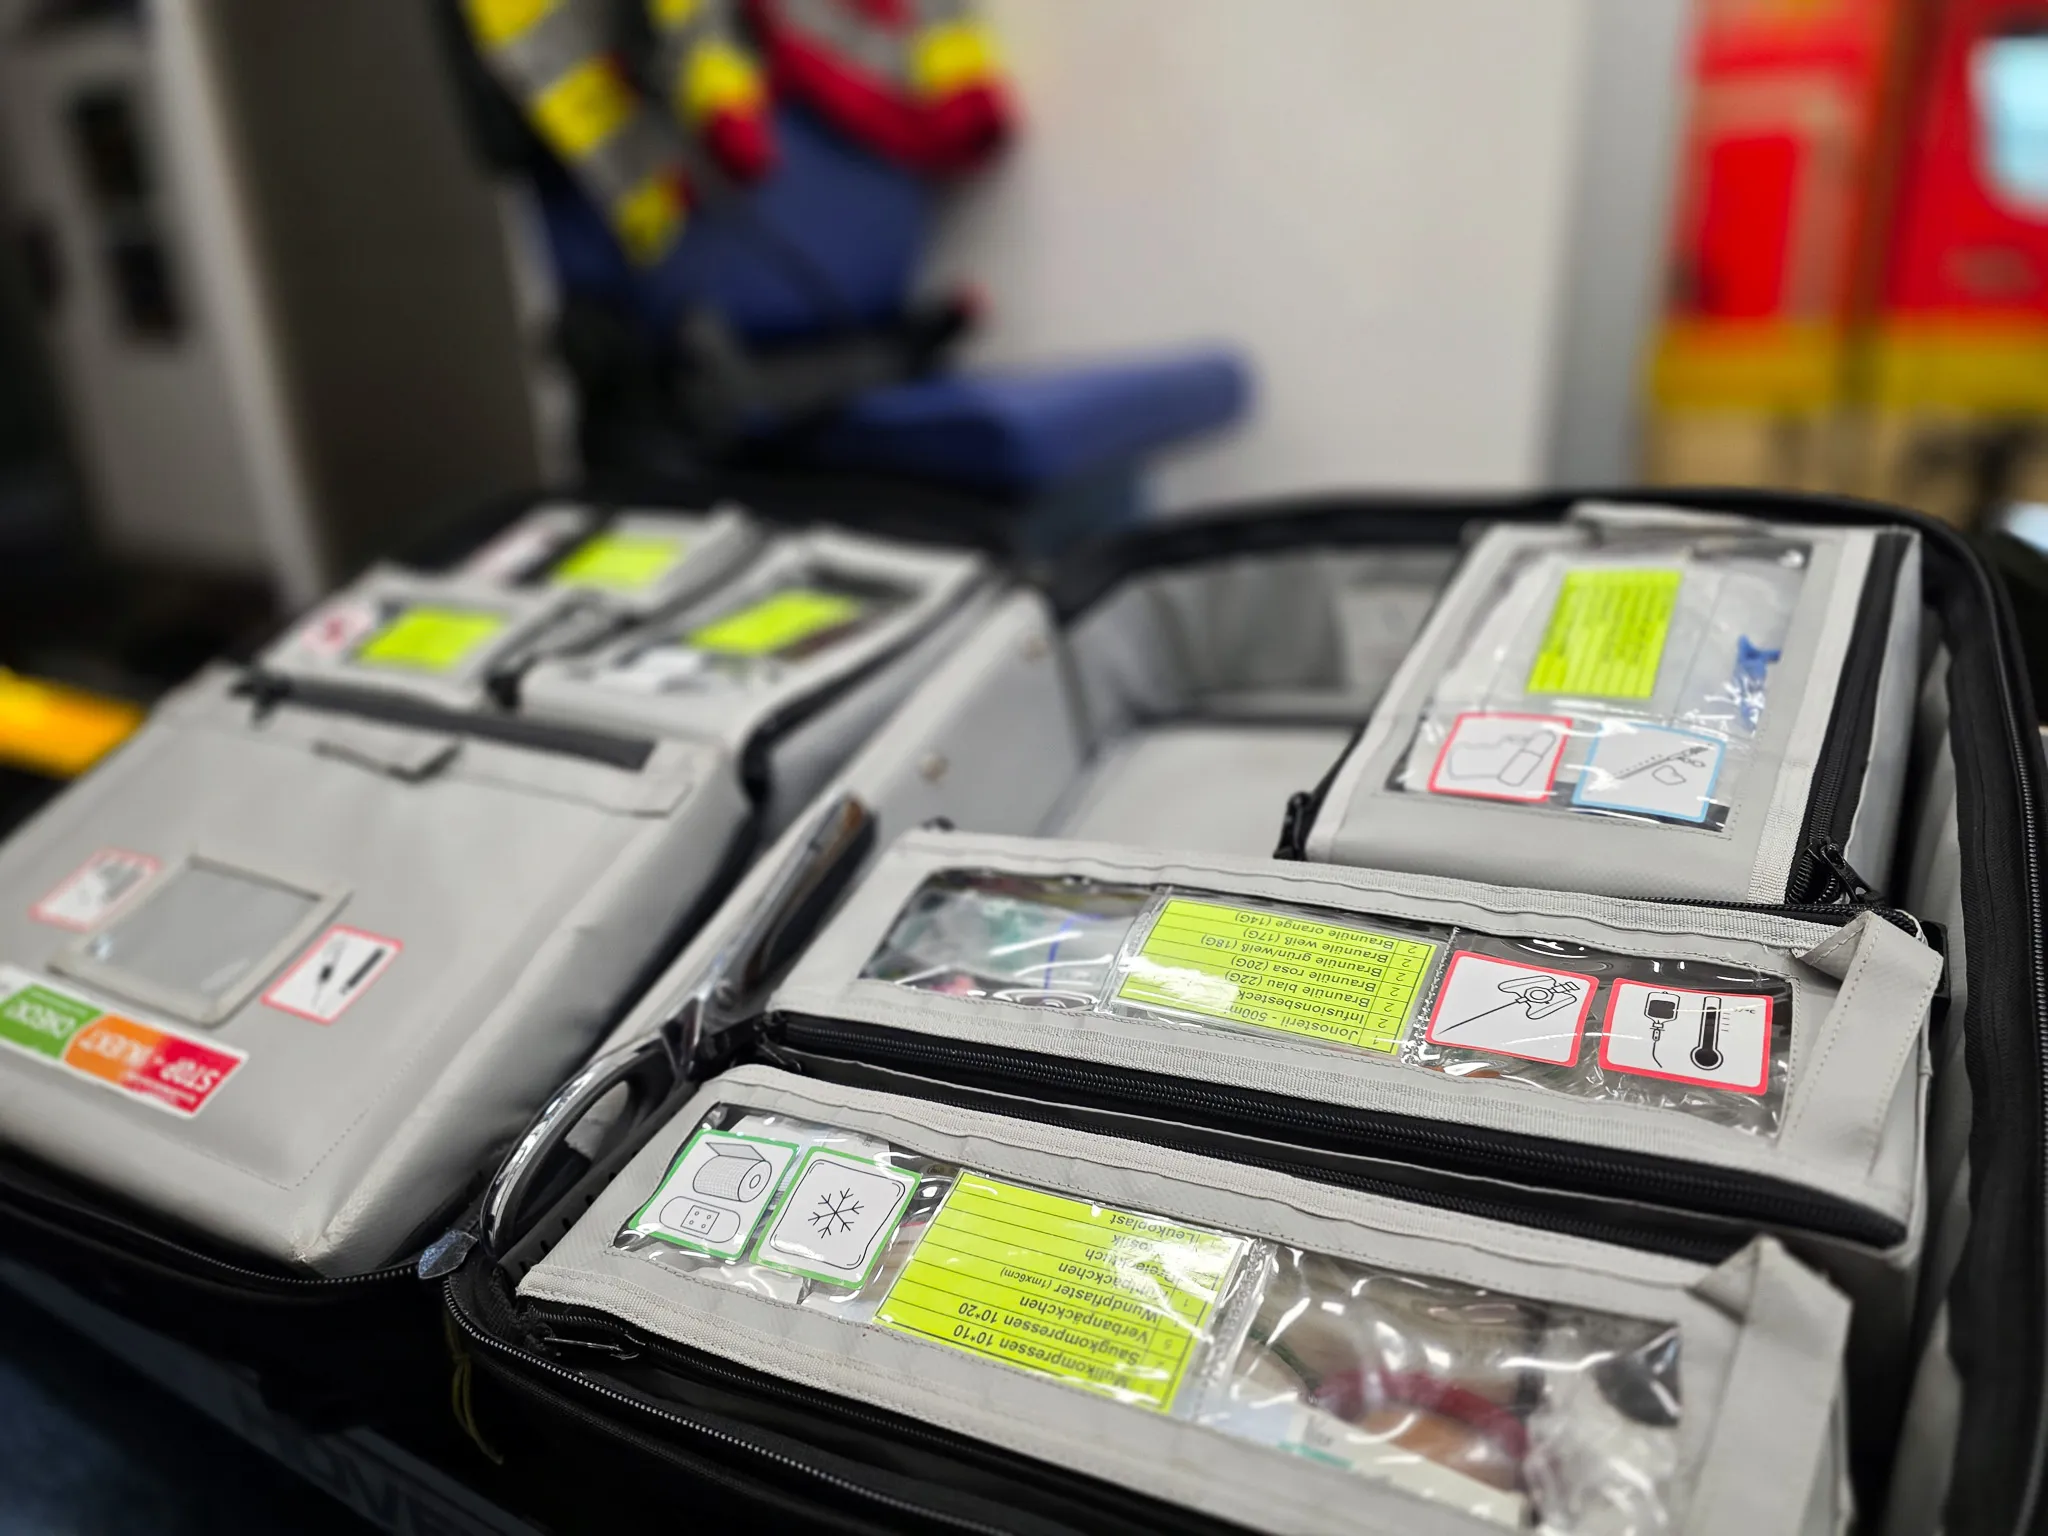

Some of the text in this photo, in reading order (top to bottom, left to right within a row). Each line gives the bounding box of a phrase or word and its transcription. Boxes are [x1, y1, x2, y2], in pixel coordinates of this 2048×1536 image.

[1234, 912, 1417, 954] 2 Braunüle orange (14G)
[1243, 928, 1411, 967] 2 Braunüle weiß (17G)
[1200, 935, 1406, 981] 2 Braunüle grün/weiß (18G)
[1231, 955, 1400, 997] 2 Braunüle rosa (20G)
[1224, 971, 1394, 1013] 2 Braunüle blau (22G)
[1237, 989, 1388, 1028] 2 Infusionsbesteck
[1280, 1016, 1358, 1040] Jonosteril
[1109, 1214, 1195, 1244] Leukoplast
[1019, 1296, 1148, 1344] Verbanpäckchen
[1053, 1284, 1158, 1323] Wundpflaster
[1002, 1315, 1140, 1365] Saugkompressen
